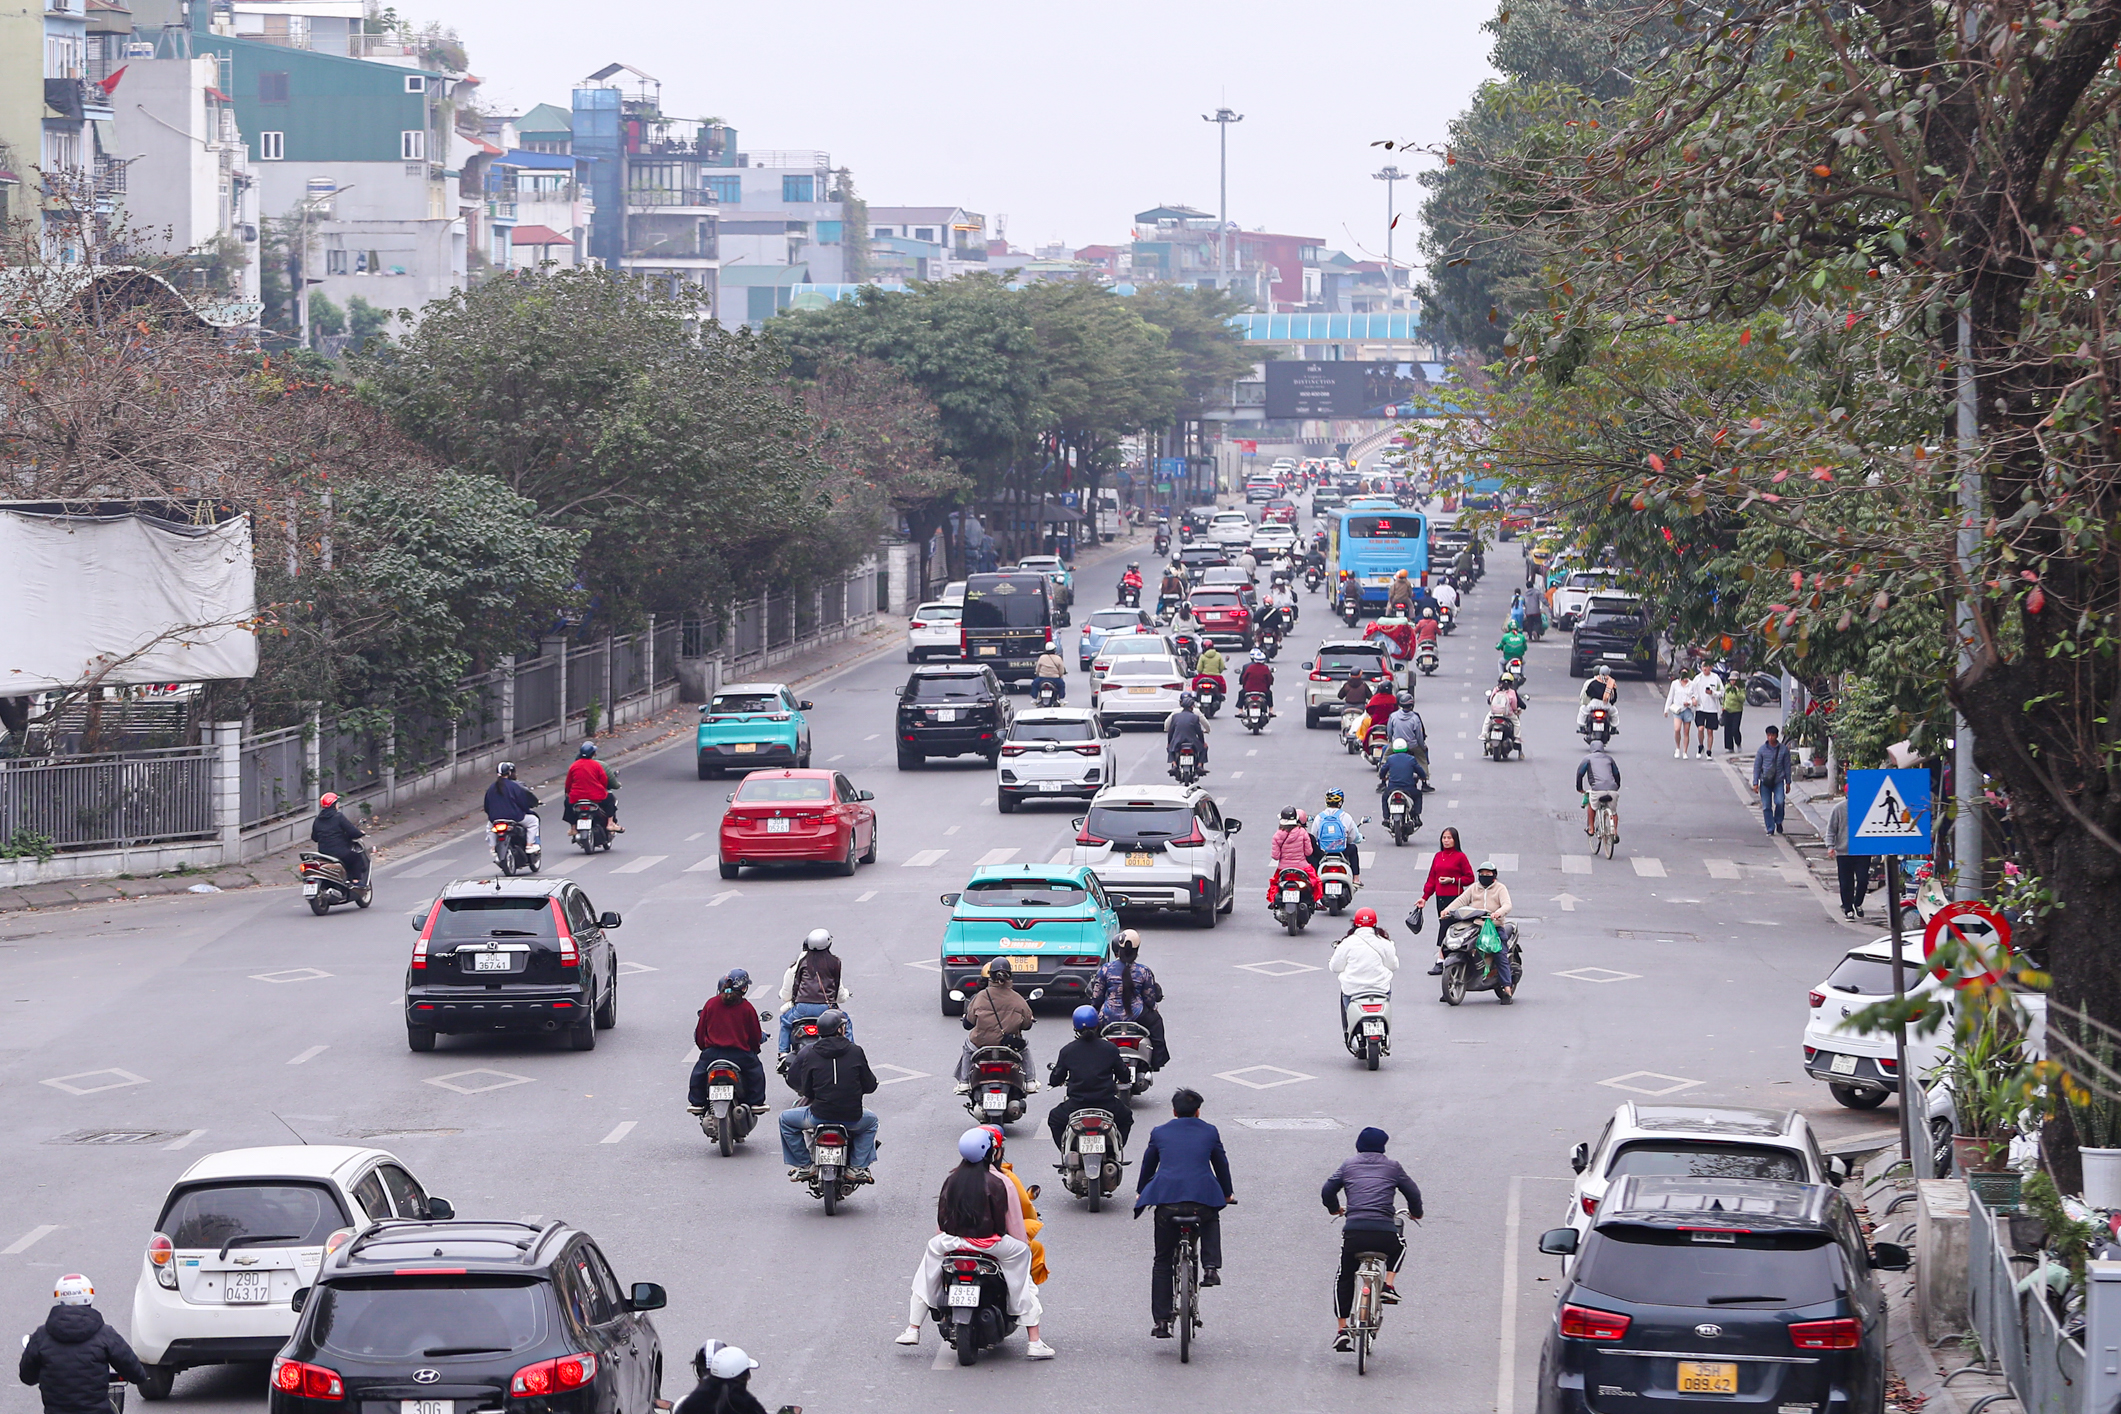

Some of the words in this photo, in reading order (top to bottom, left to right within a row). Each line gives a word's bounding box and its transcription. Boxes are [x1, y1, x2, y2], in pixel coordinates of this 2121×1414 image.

[1066, 496, 1073, 505] P
[769, 824, 788, 832] 052.61
[1081, 1144, 1103, 1152] 277.88
[236, 1273, 259, 1286] 29D
[60, 1290, 82, 1298] HDBank
[226, 1287, 268, 1301] 043.17
[950, 1296, 977, 1306] 382.59
[1695, 1364, 1720, 1377] 35H
[1684, 1378, 1730, 1391] 089.42
